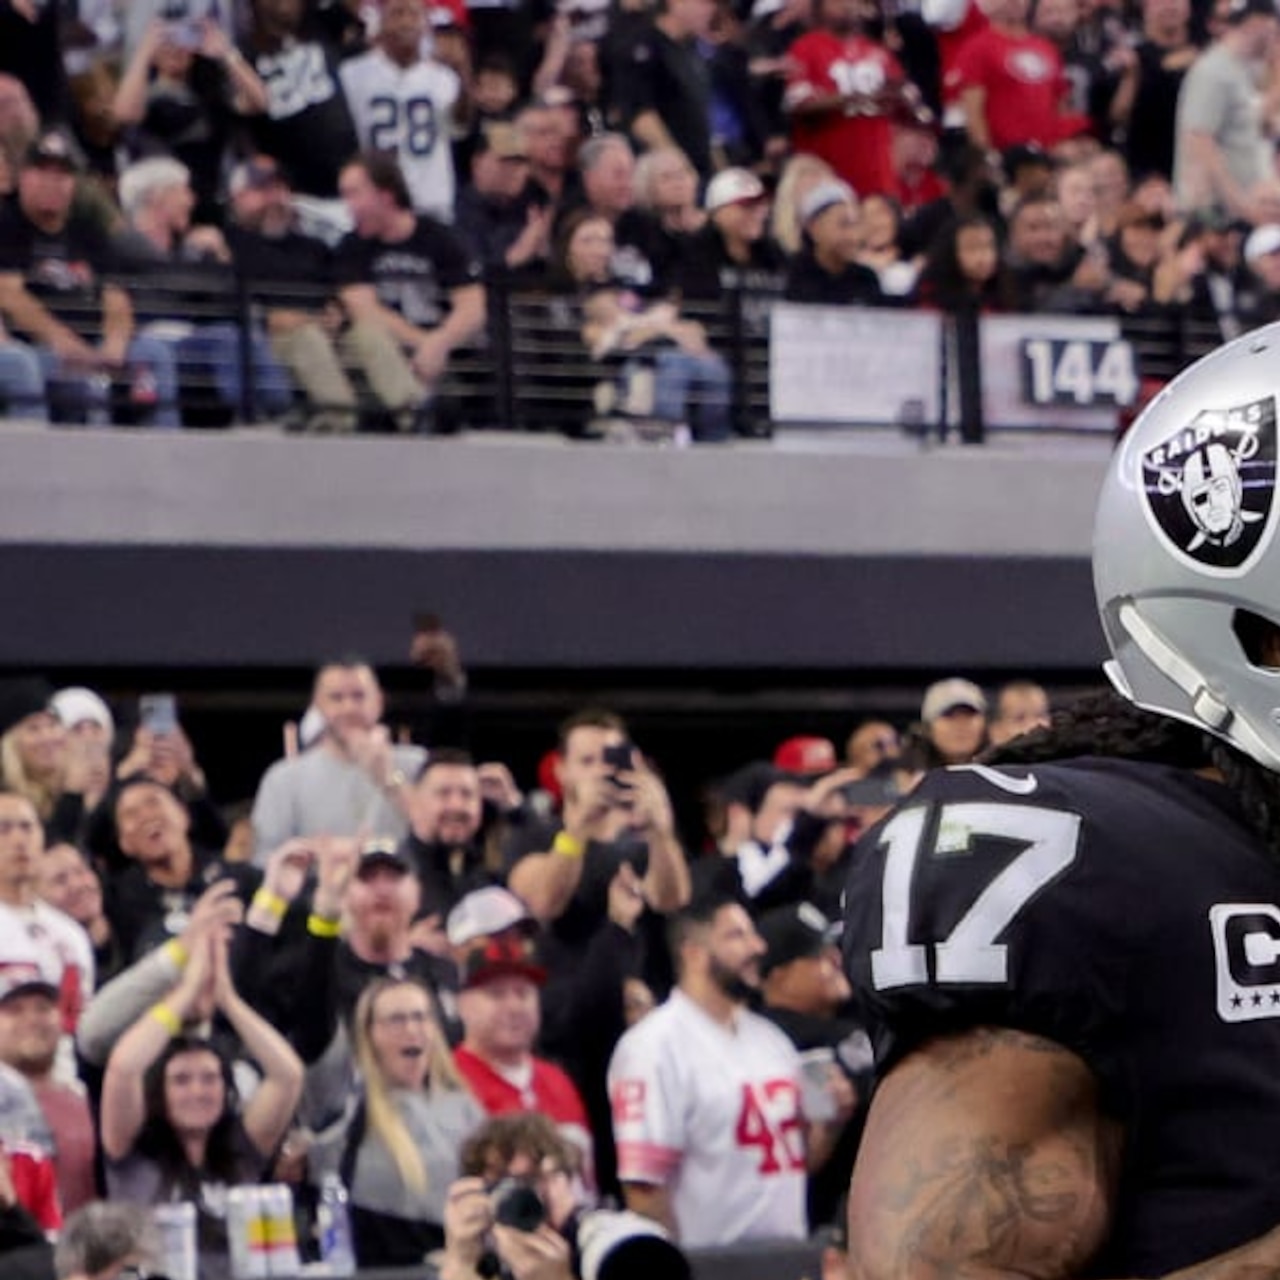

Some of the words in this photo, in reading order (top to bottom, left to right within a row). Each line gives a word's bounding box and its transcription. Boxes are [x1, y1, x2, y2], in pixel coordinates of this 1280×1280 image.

[369, 96, 436, 155] 28
[1026, 341, 1136, 405] 144
[870, 802, 1081, 991] 17
